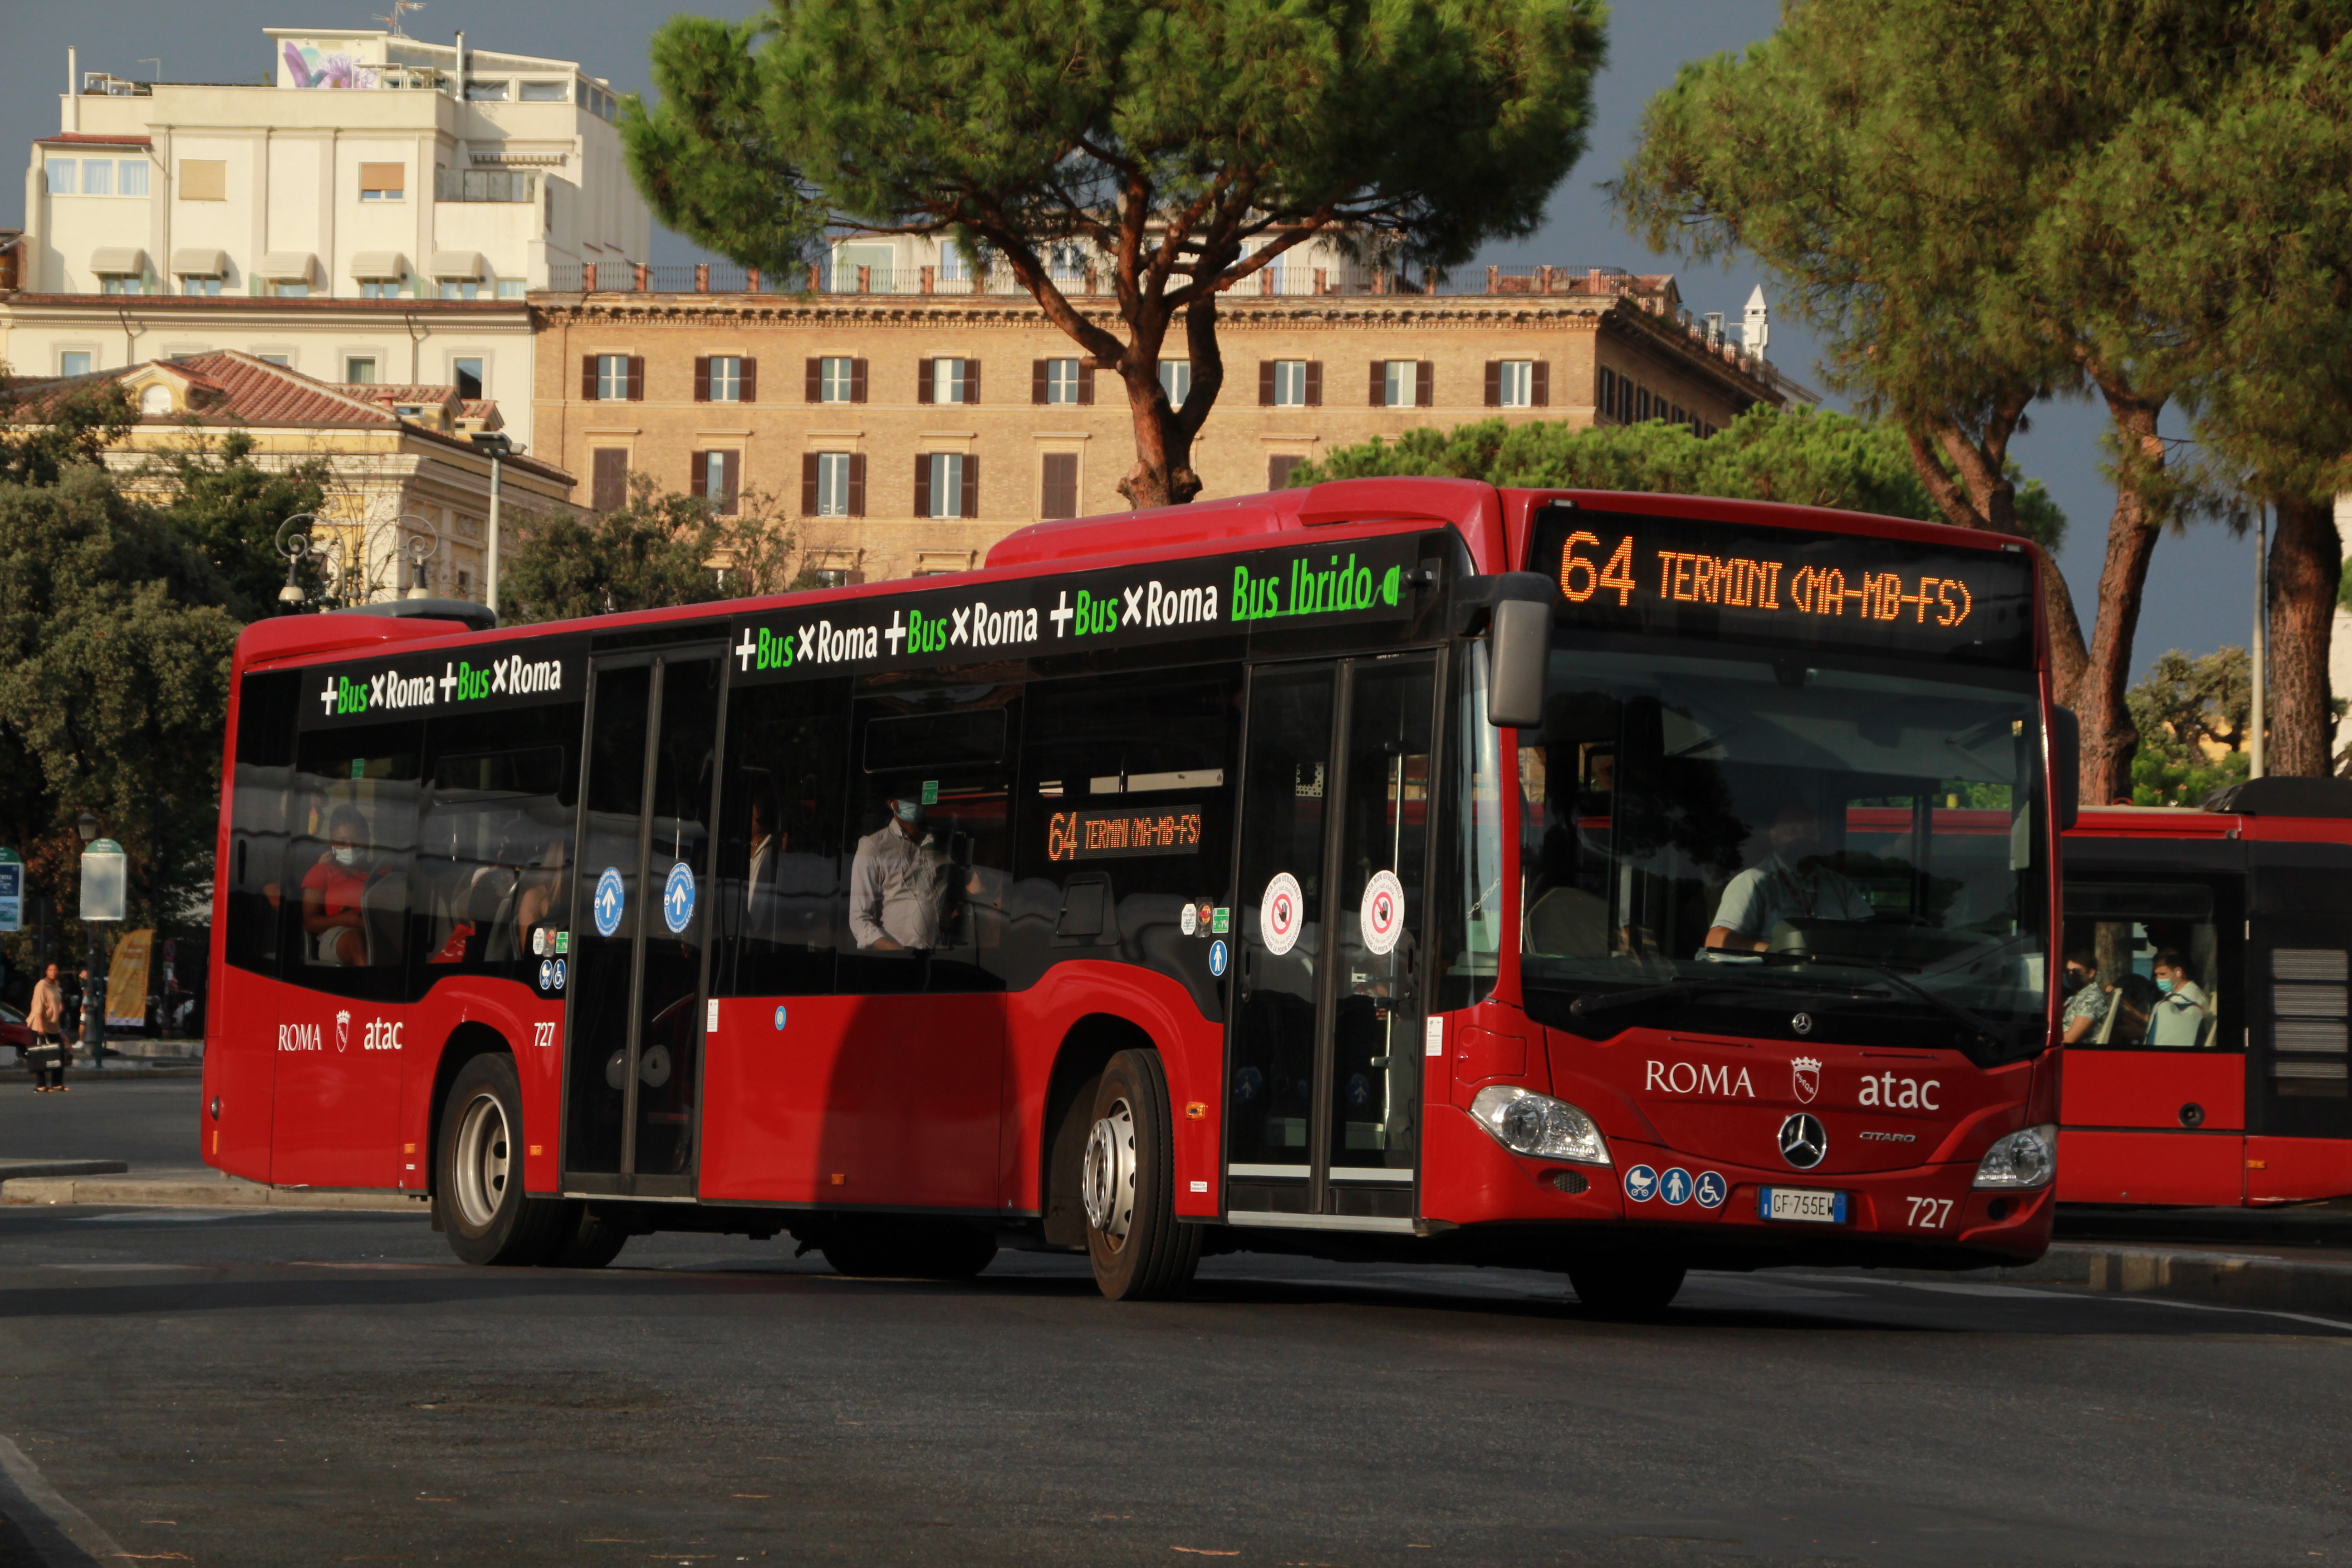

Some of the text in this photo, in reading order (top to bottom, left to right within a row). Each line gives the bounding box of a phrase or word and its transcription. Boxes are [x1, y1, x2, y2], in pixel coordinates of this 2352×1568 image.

[1231, 565, 1280, 622] Bus
[1289, 553, 1372, 615] Ibrido
[1559, 530, 1971, 627] 64 TERMINI (MA-MB-FS)
[1049, 812, 1078, 861] 64
[1085, 818, 1129, 849] TERMINI
[1264, 875, 1301, 905] PORTA NON UTILIZZABILE
[1284, 886, 1294, 897] usable
[1364, 872, 1402, 903] PORTA NON UTILIZZABILE
[1385, 883, 1395, 896] usable
[1262, 923, 1274, 949] UTILIZZARE
[1287, 918, 1301, 948] POSTERIORE
[1362, 921, 1374, 948] UTILIZZARE
[1377, 944, 1388, 952] PORTA
[1388, 918, 1402, 948] POSTERIORE
[278, 1024, 322, 1052] ROMA
[364, 1017, 403, 1050] atac
[534, 1022, 555, 1047] 727
[1645, 1059, 1756, 1098] ROMA
[1798, 1076, 1815, 1095] SPQR
[1858, 1070, 1941, 1111] atac
[1859, 1131, 1916, 1143] CITARO
[1906, 1196, 1954, 1229] 727
